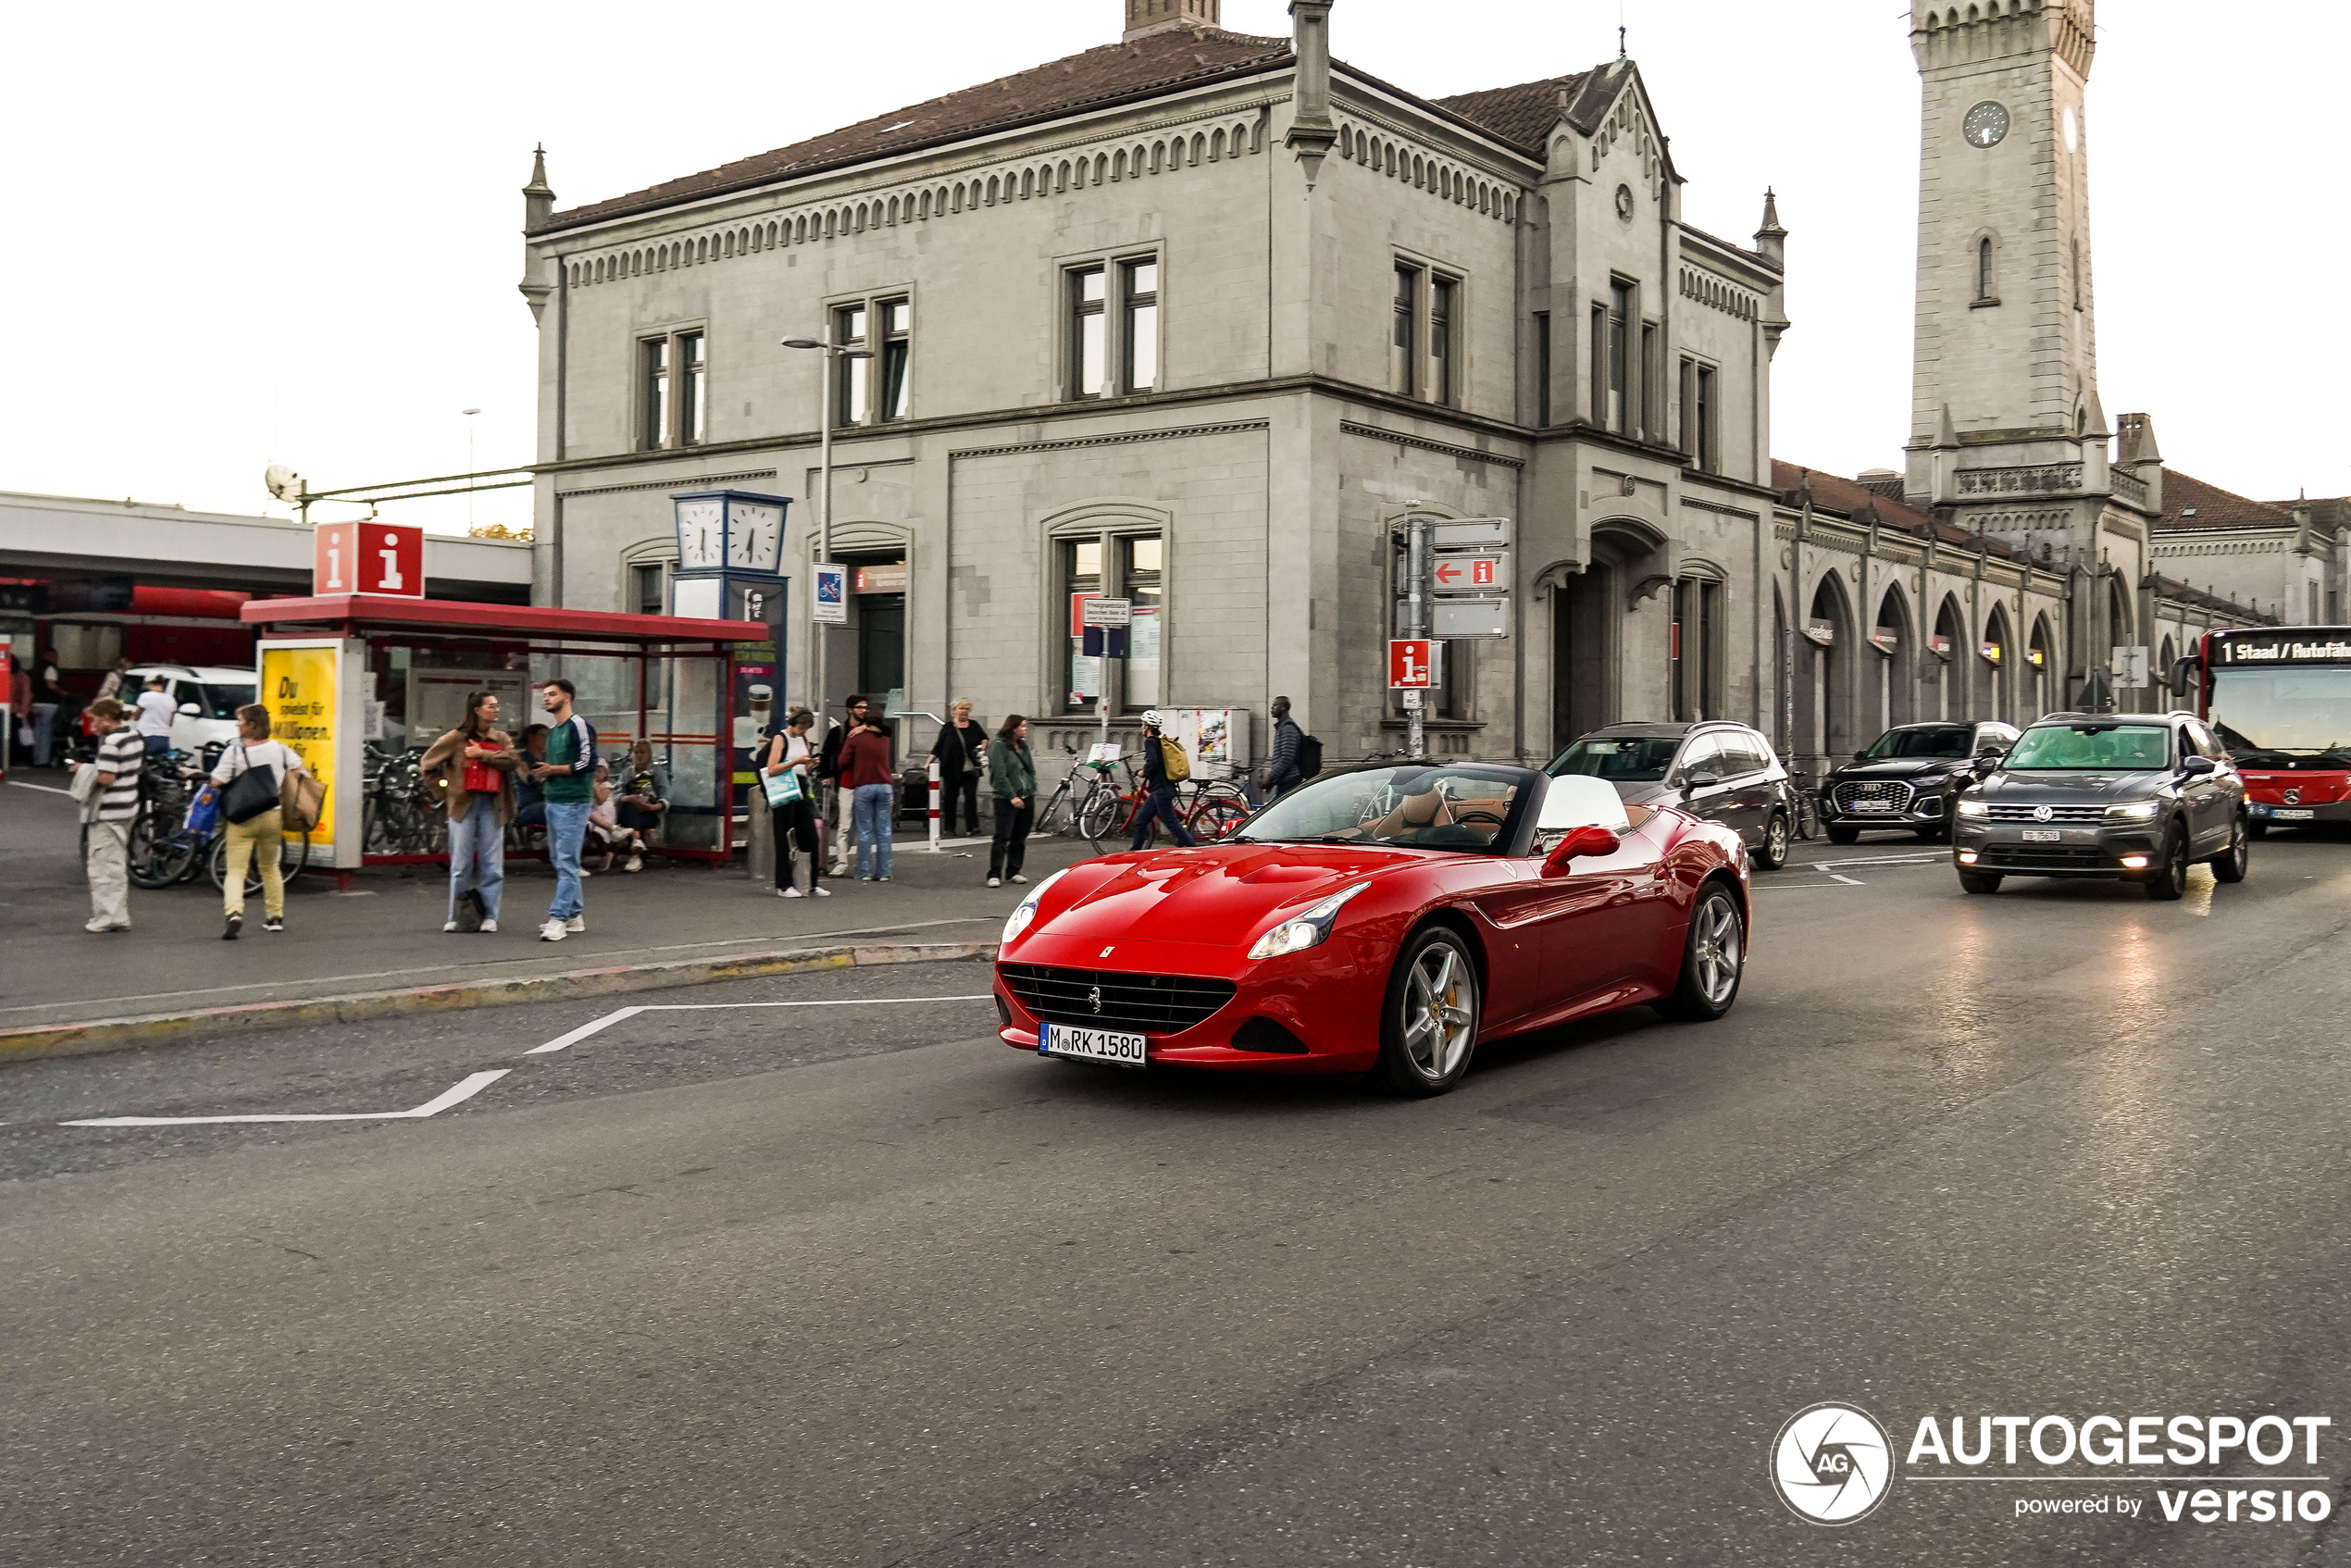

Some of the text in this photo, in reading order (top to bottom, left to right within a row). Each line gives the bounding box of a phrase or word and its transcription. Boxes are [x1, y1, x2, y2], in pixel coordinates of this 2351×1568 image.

[2222, 641, 2232, 663] 1
[2236, 643, 2279, 659] Staad
[279, 677, 298, 699] Du
[311, 702, 324, 719] für
[1050, 1027, 1142, 1059] M RK 1580
